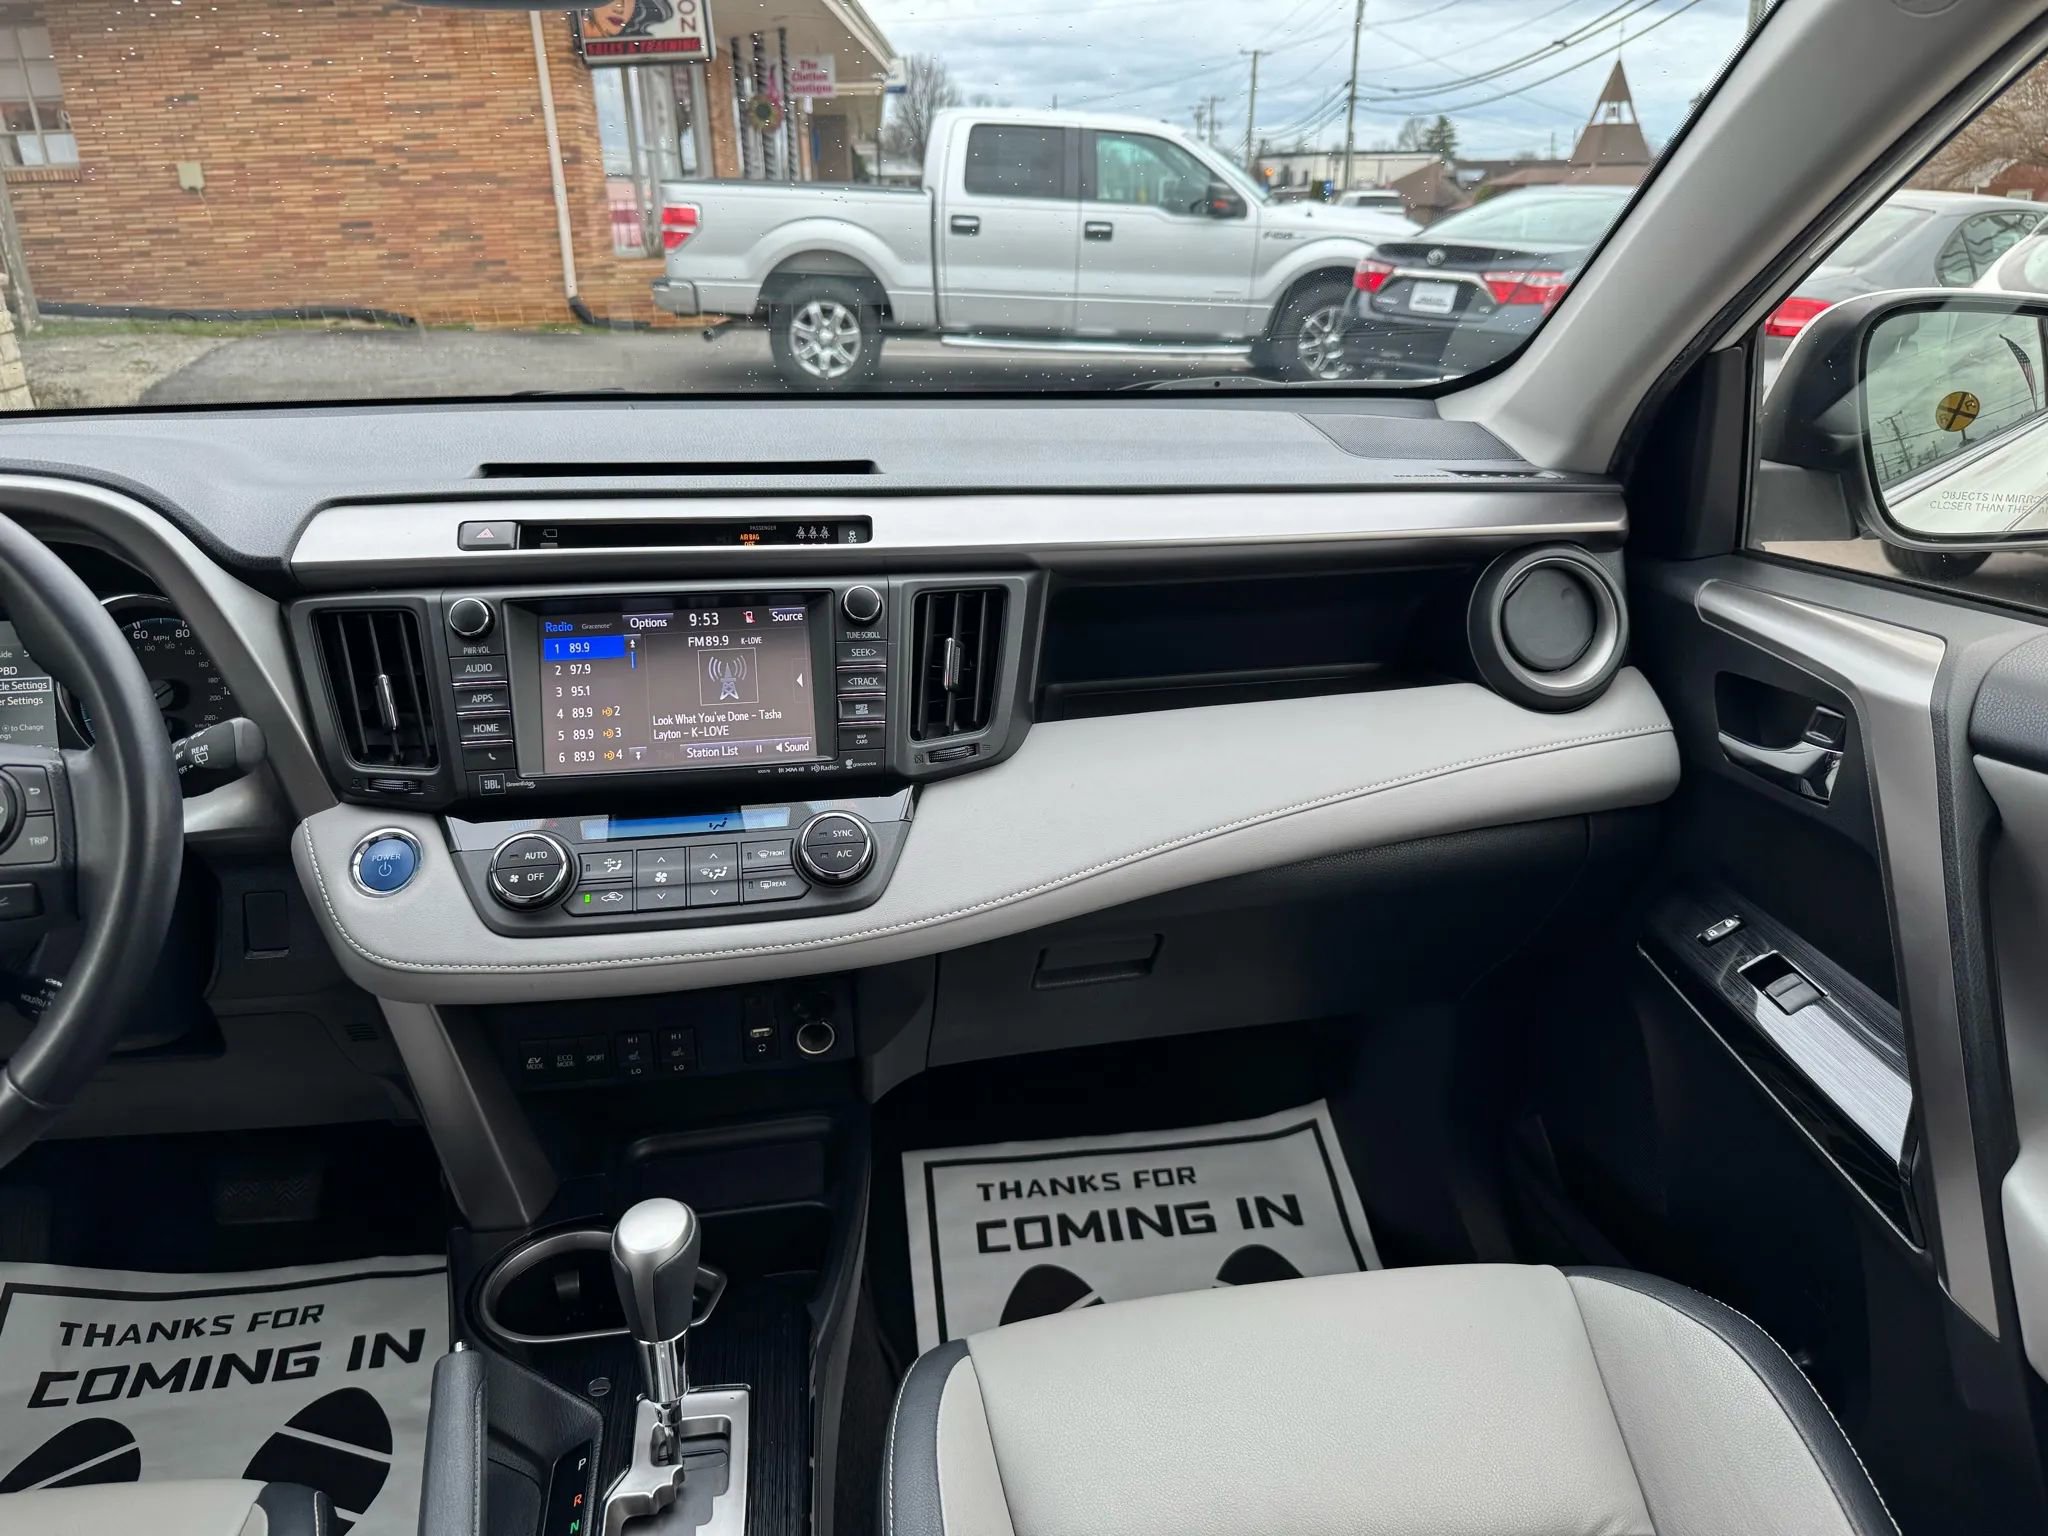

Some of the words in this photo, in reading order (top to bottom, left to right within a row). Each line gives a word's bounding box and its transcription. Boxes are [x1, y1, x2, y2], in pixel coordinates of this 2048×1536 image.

[1941, 491, 1989, 501] OBJECTS
[1991, 493, 2003, 501] IN
[1929, 500, 1972, 511] CLOSER
[1975, 502, 2004, 513] THAN
[689, 612, 719, 626] 9:53
[772, 611, 803, 622] Source
[545, 622, 574, 632] Radio
[630, 617, 668, 630] Options
[133, 630, 148, 639] 60
[175, 629, 190, 638] 80
[741, 636, 762, 644] K-LOVE
[554, 644, 560, 654] 1
[569, 642, 590, 653] 89.9
[465, 663, 493, 673] AUDIO
[555, 665, 562, 676] 2
[570, 663, 591, 675] 97.9
[11, 681, 48, 692] Settings
[556, 687, 562, 697] 3
[571, 685, 591, 697] 95.1
[7, 696, 44, 706] Settings
[472, 694, 494, 703] APPS
[557, 708, 564, 719] 4
[572, 707, 593, 718] 89.9
[653, 714, 673, 726] Look
[675, 713, 696, 724] What
[698, 711, 726, 723] You've
[728, 710, 749, 721] Done
[759, 708, 782, 719] Tasha
[473, 723, 500, 733] HOME
[558, 730, 565, 741] 5
[573, 728, 594, 740] 89.9
[653, 729, 681, 741] Layton
[191, 744, 209, 755] REAR
[686, 747, 719, 758] Station
[722, 746, 739, 756] List
[784, 741, 809, 752] Sound
[559, 752, 566, 763] 6
[574, 750, 595, 762] 89.9
[178, 766, 188, 775] OFF
[484, 779, 501, 790] JBL
[832, 829, 853, 837] SYNC
[29, 836, 49, 846] TRIP
[371, 853, 401, 862] POWER
[525, 851, 548, 860] AUTO
[836, 849, 853, 858] A/C
[527, 872, 545, 881] OFF
[586, 1053, 605, 1061] SPORT
[977, 1172, 1121, 1201] THANKS
[1134, 1166, 1197, 1189] FOR
[976, 1201, 1217, 1254] COMING
[1236, 1194, 1304, 1230] IN
[59, 1314, 235, 1347] THANKS
[247, 1304, 325, 1333] FOR
[27, 1341, 323, 1409] COMING
[346, 1328, 426, 1372] IN
[578, 1457, 587, 1471] P
[573, 1493, 583, 1507] R
[570, 1519, 580, 1535] N
